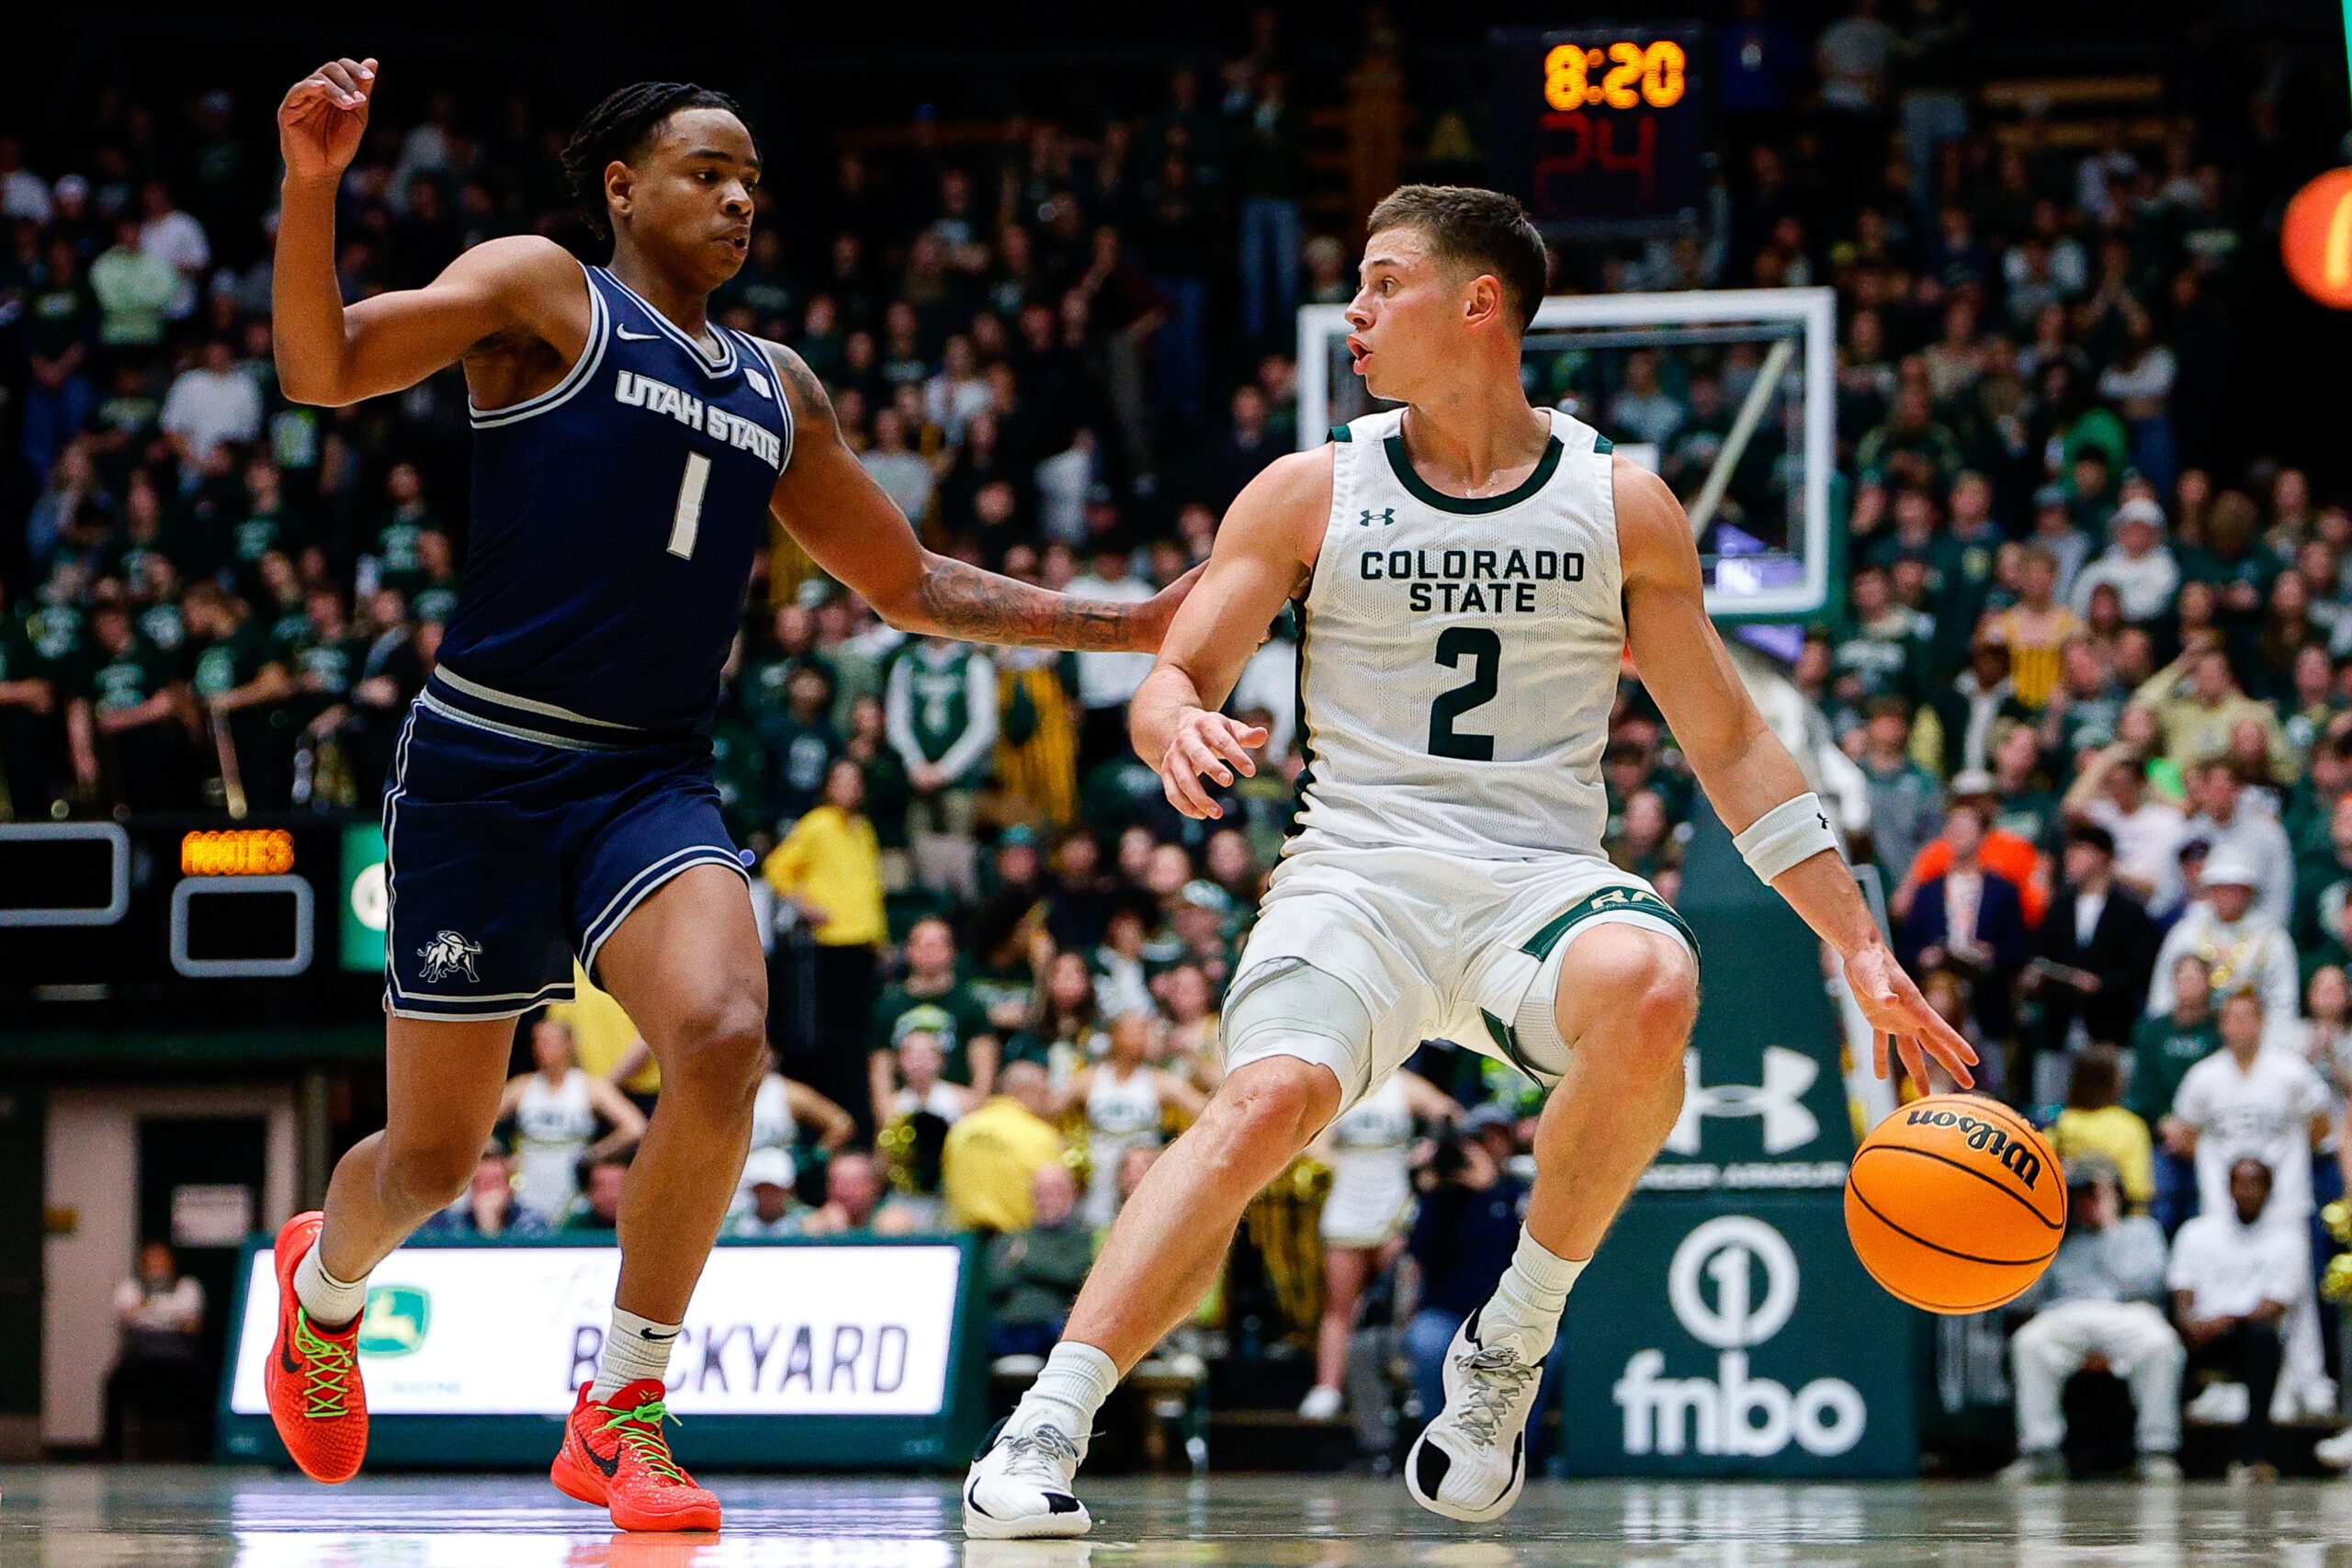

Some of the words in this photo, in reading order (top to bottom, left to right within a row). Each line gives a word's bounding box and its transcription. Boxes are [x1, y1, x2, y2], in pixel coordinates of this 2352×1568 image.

[1544, 40, 1686, 111] 8:20
[1535, 111, 1657, 217] 24
[615, 369, 703, 432] UTAH
[707, 404, 781, 470] STATE
[666, 450, 712, 561] 1
[1361, 549, 1585, 582] COLORADO
[1409, 582, 1536, 613] STATE
[1427, 626, 1501, 761] 2
[1906, 1109, 2041, 1192] Wilson
[568, 1325, 910, 1393] BCKYARD
